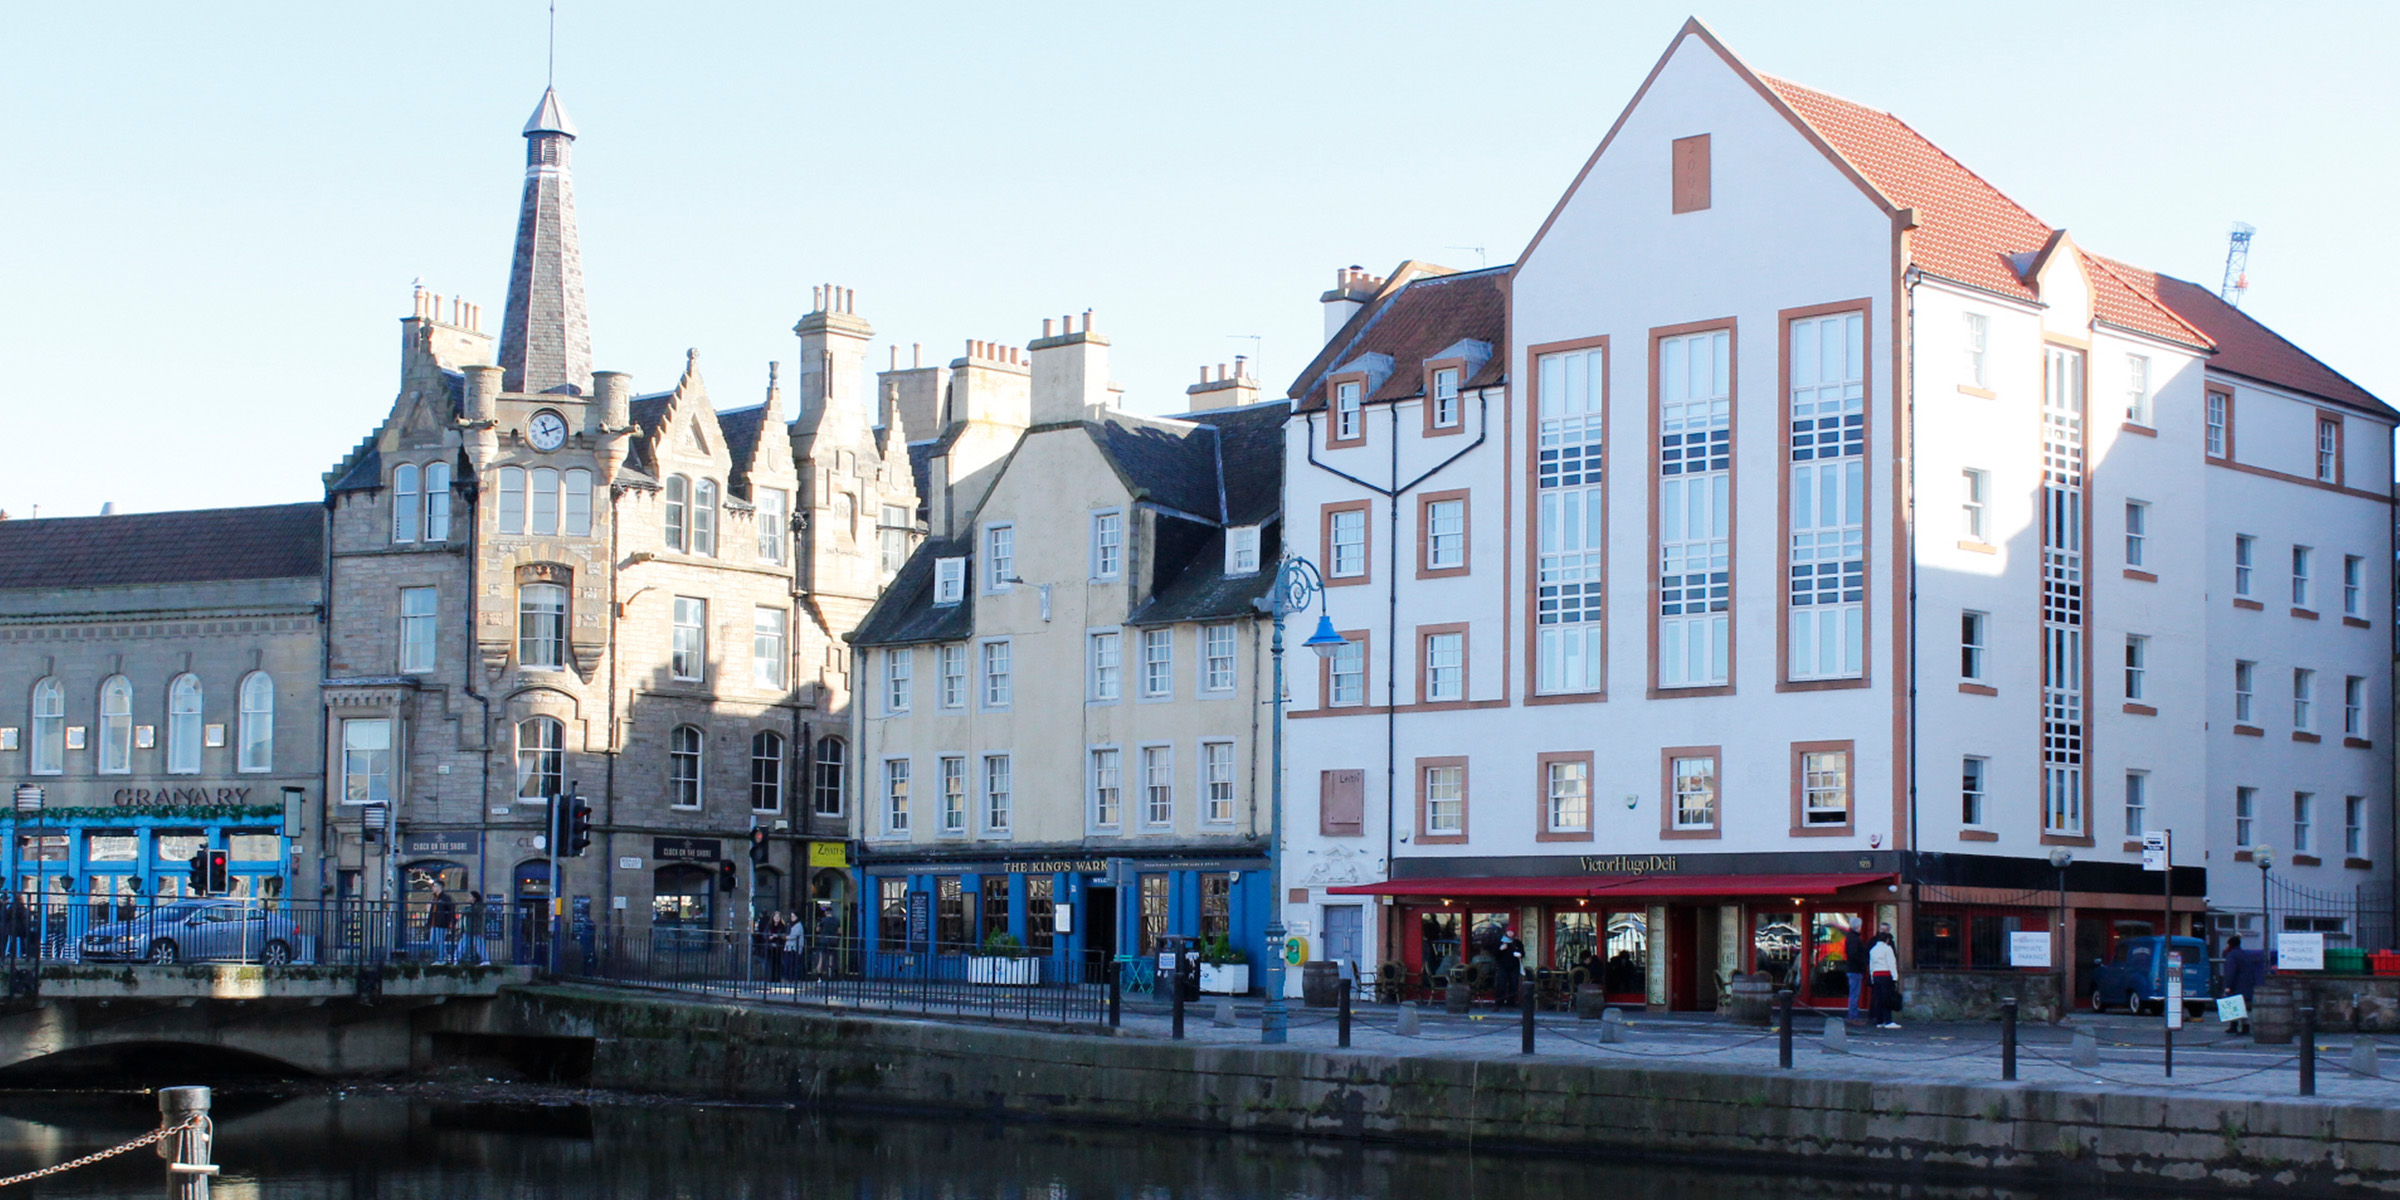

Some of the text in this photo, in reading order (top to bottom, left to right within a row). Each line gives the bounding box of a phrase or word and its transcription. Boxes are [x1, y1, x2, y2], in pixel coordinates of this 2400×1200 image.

[114, 787, 251, 806] GRANARY
[413, 842, 468, 851] CLOCK ON THE SHORE
[663, 847, 678, 857] CLOCK
[679, 848, 686, 857] ON
[687, 848, 696, 857] THE
[696, 849, 712, 858] SHORE
[1003, 860, 1108, 872] THE KING'S WARK
